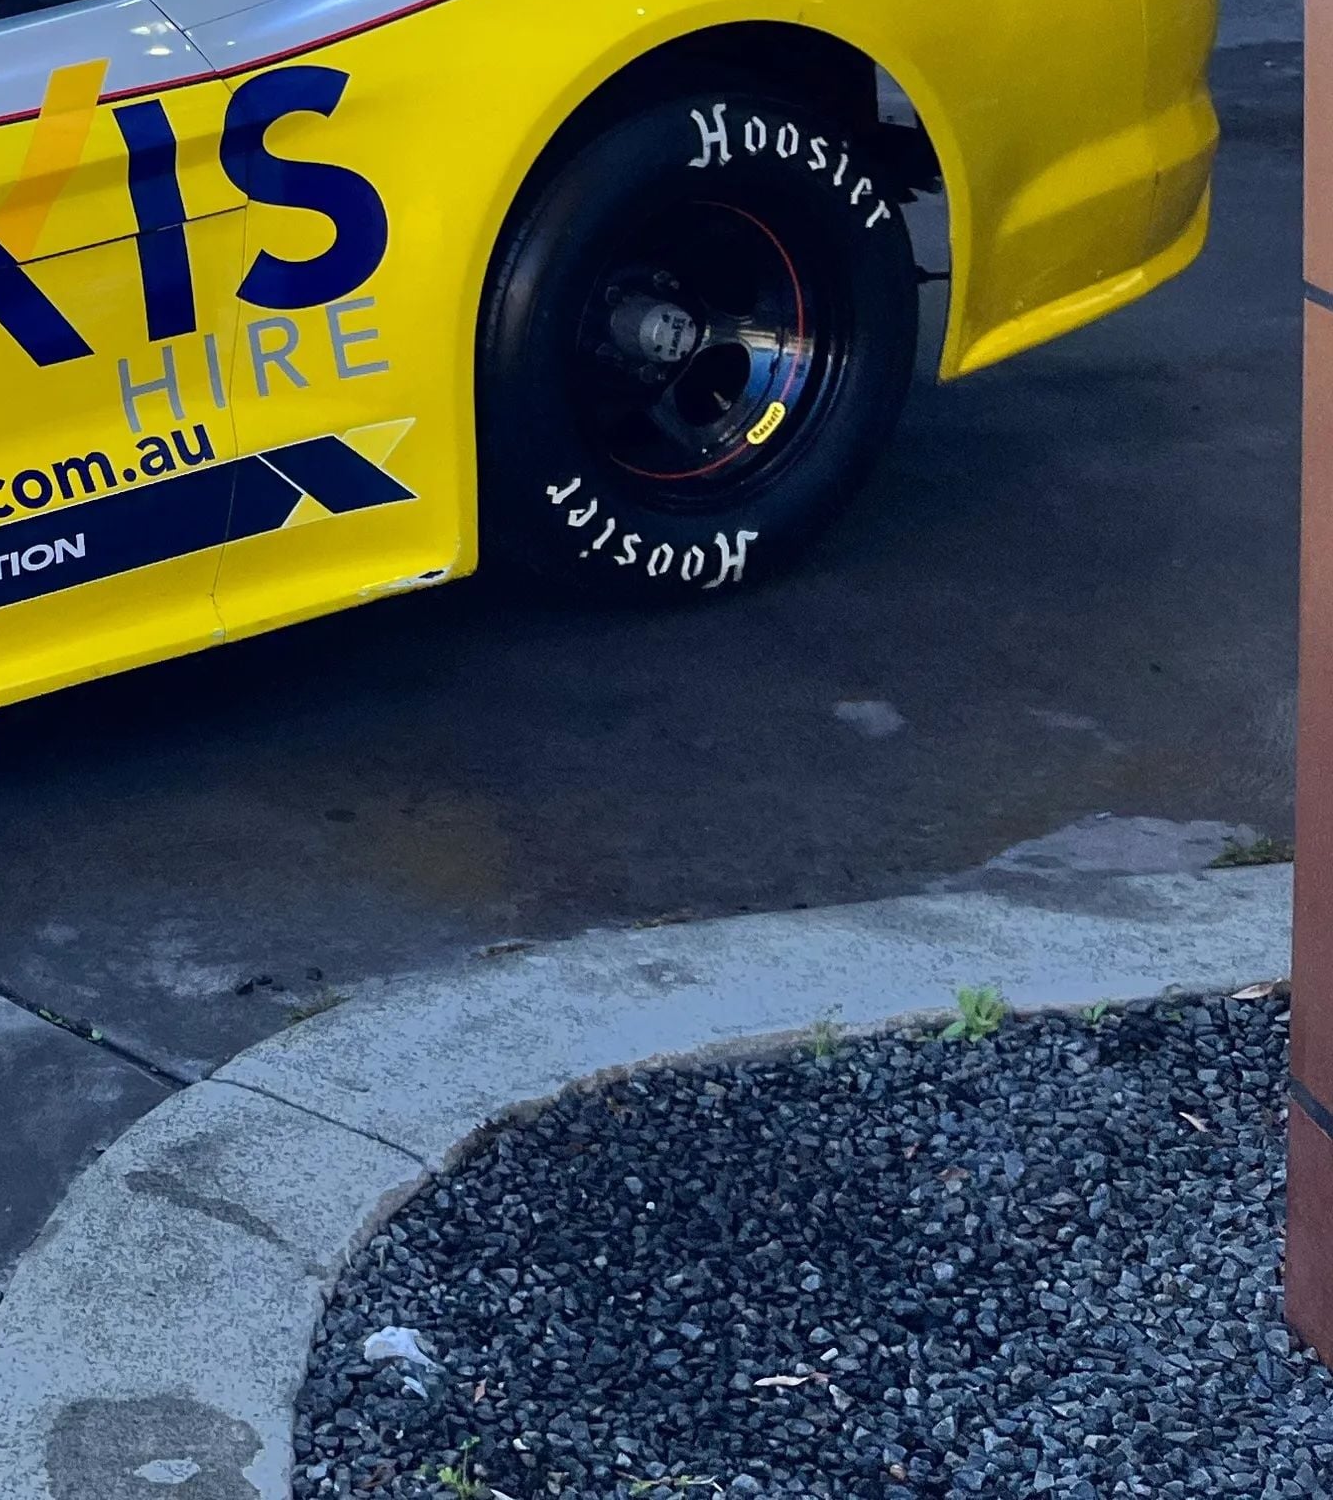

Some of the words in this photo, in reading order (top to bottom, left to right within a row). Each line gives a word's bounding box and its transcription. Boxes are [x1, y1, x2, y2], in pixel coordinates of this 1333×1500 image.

[689, 103, 892, 228] Hoosier
[118, 296, 390, 434] HIRE
[545, 477, 759, 590] Hoosier
